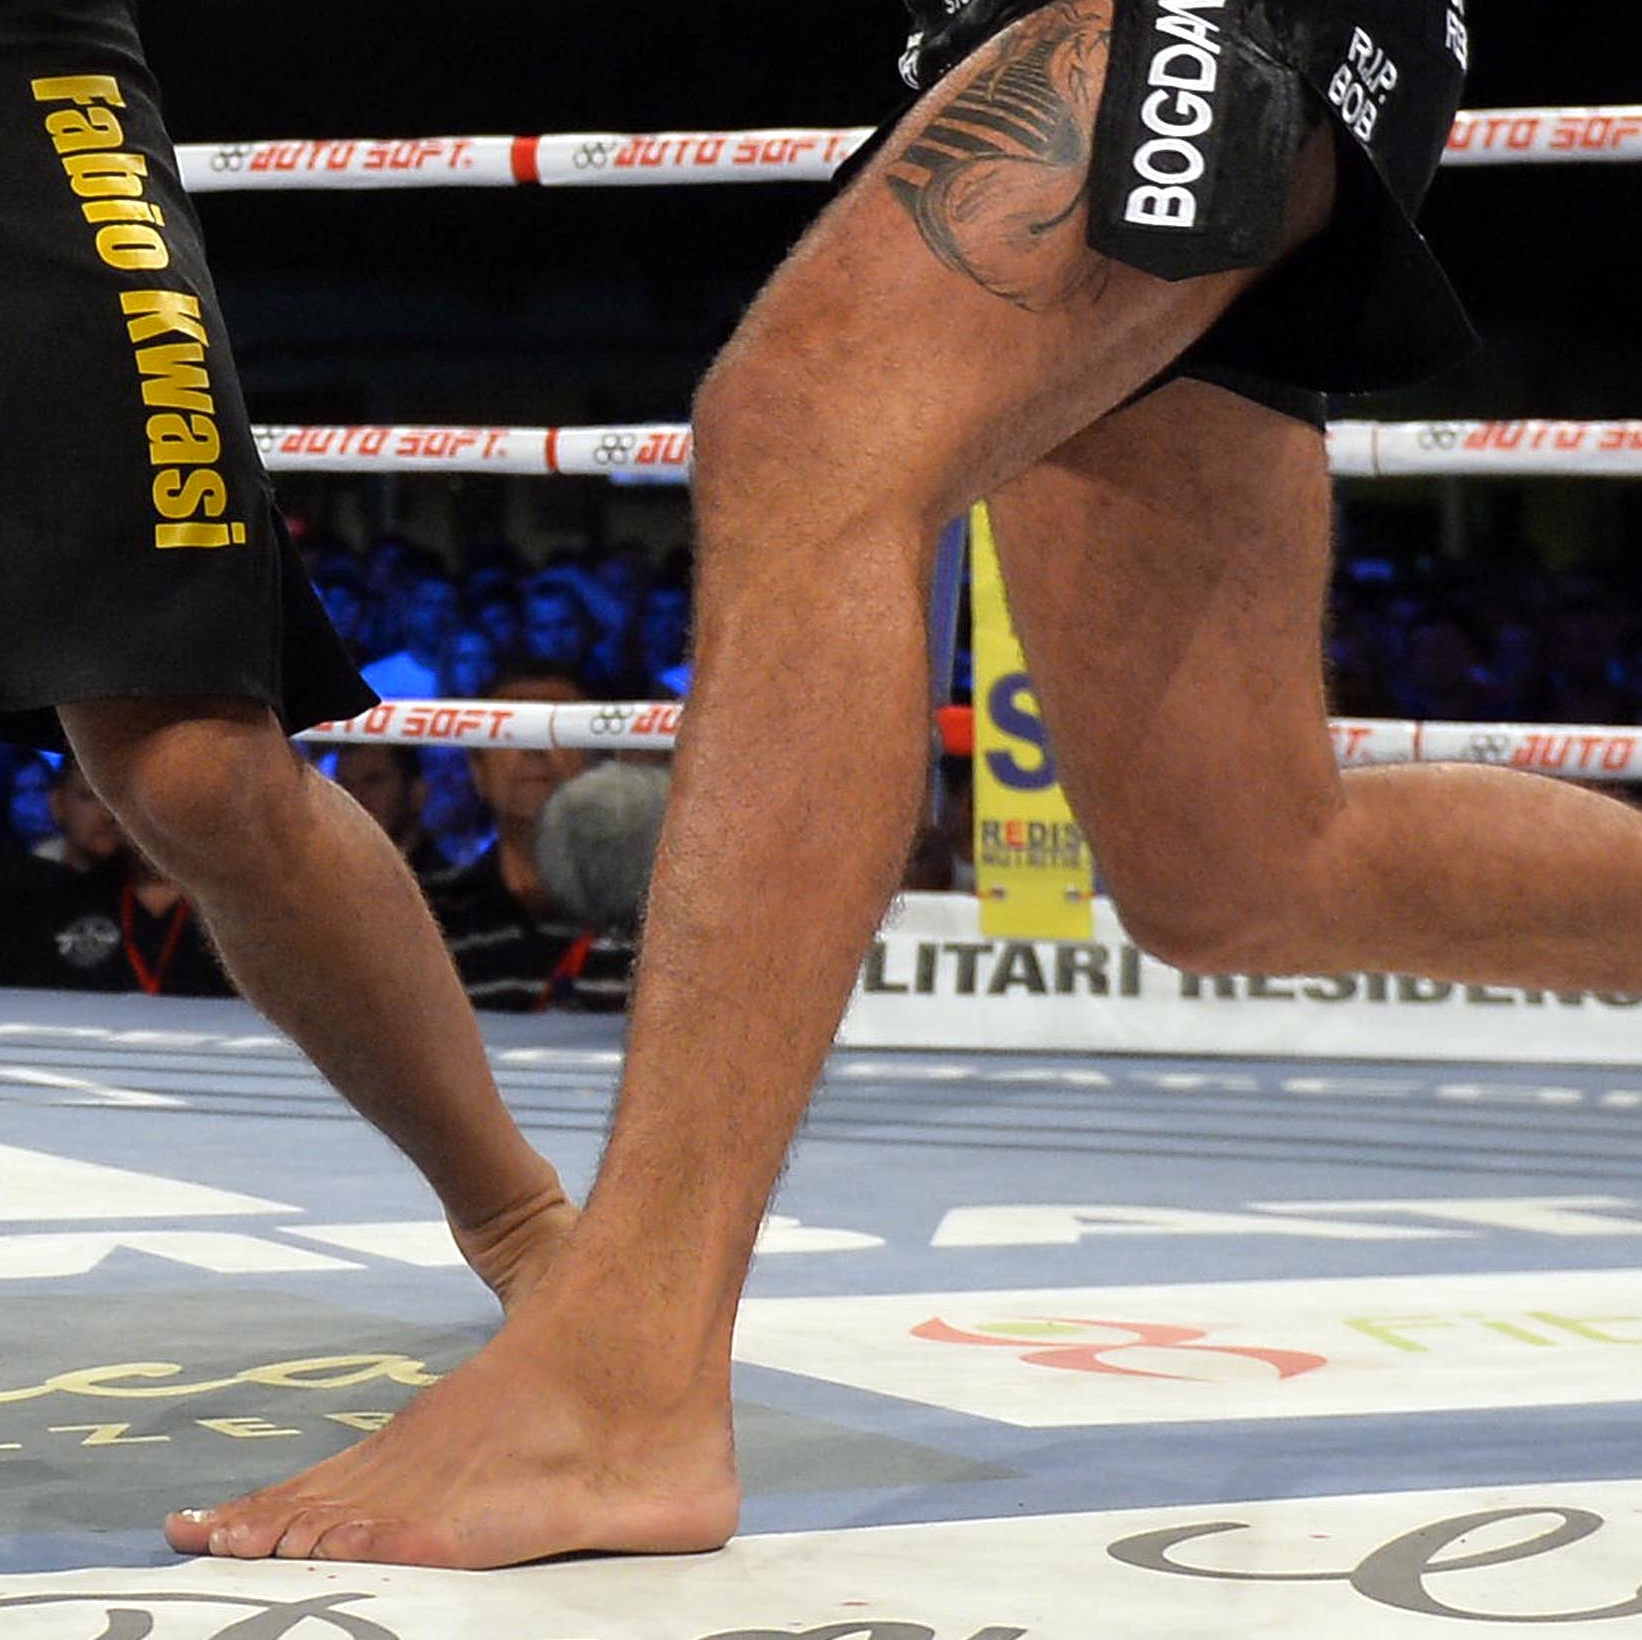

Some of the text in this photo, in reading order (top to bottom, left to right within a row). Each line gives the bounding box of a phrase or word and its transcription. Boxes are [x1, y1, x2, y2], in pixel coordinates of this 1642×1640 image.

[1328, 63, 1378, 143] BOB
[1447, 118, 1541, 151] UTO
[30, 74, 247, 550] Fabio Kwasi
[1509, 735, 1636, 770] AUTO
[981, 820, 1082, 849] REDIS
[862, 941, 1142, 999] LITARI
